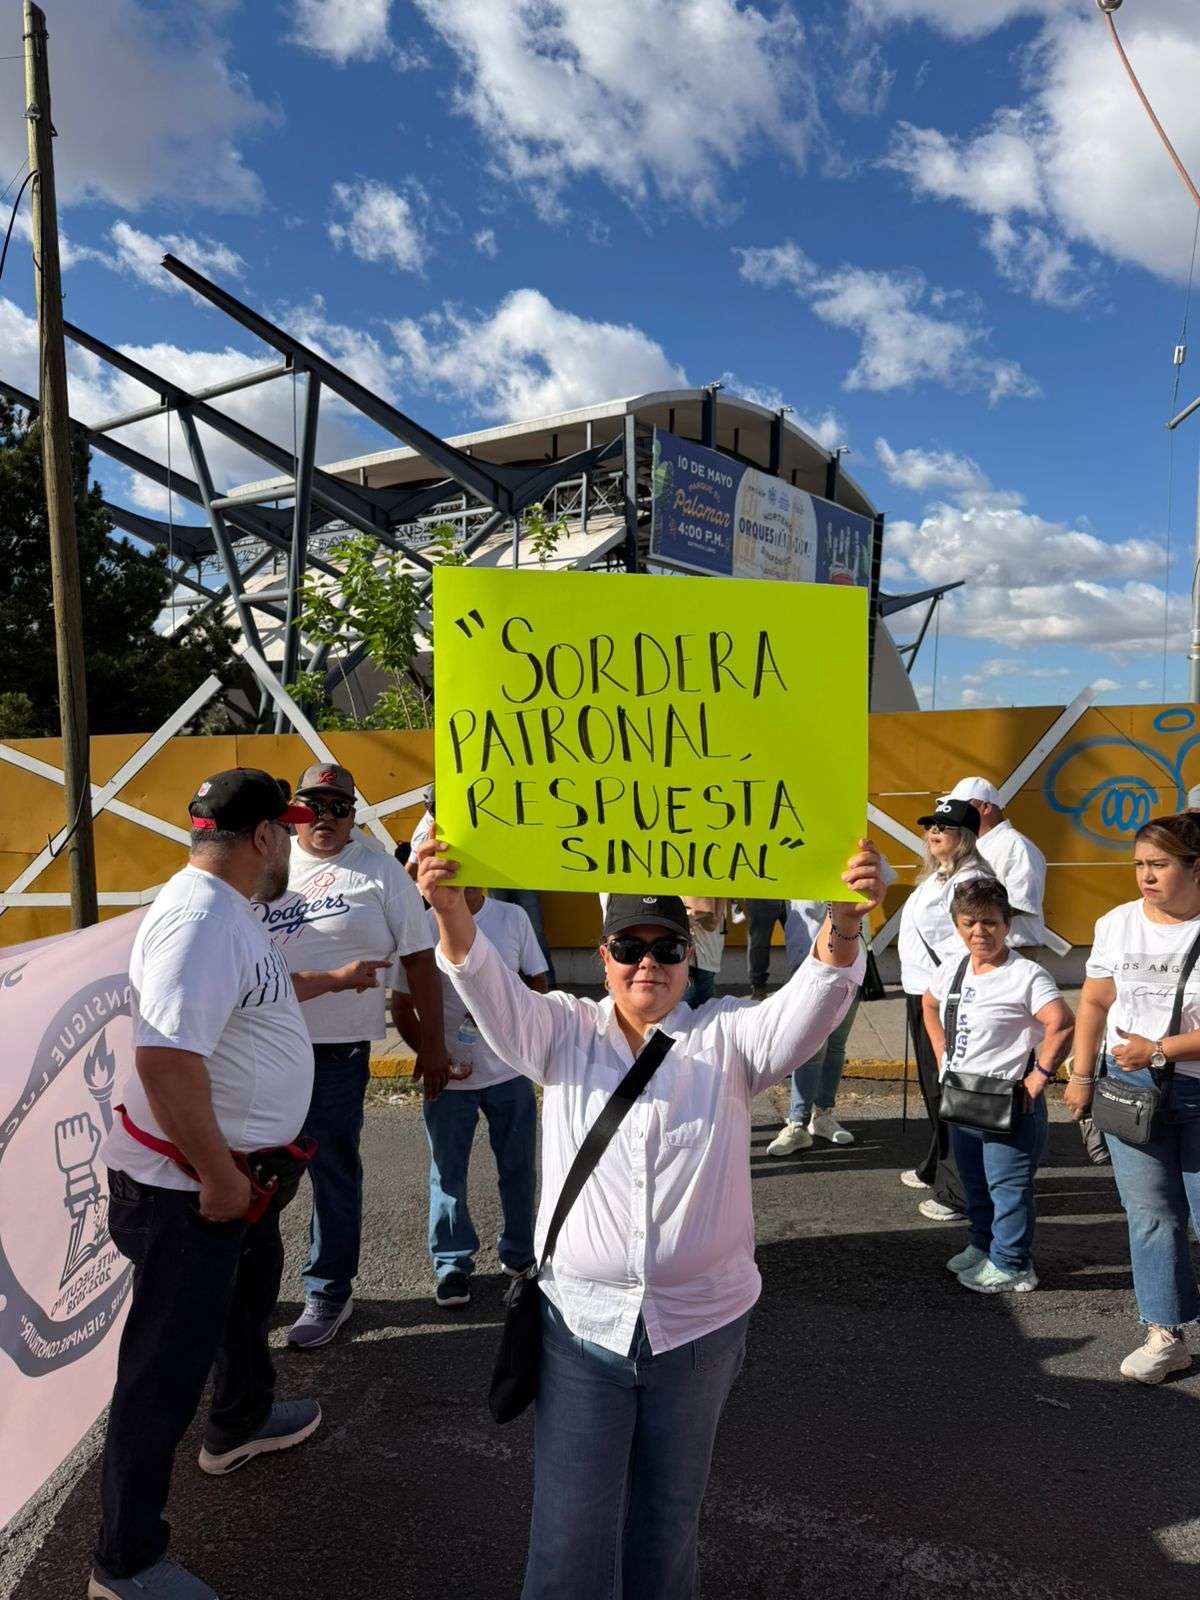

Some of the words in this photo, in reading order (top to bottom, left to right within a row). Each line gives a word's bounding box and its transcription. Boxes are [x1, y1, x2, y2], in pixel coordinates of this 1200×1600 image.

[678, 456, 688, 471] 10
[690, 461, 705, 477] DE
[707, 468, 733, 488] MAYO
[673, 488, 731, 528] Palomar
[678, 521, 702, 540] 4:00
[704, 530, 725, 547] P.M.
[448, 701, 753, 774] PATRONAL,
[466, 776, 805, 834] RESPUESTA
[250, 893, 350, 933] Dodgers
